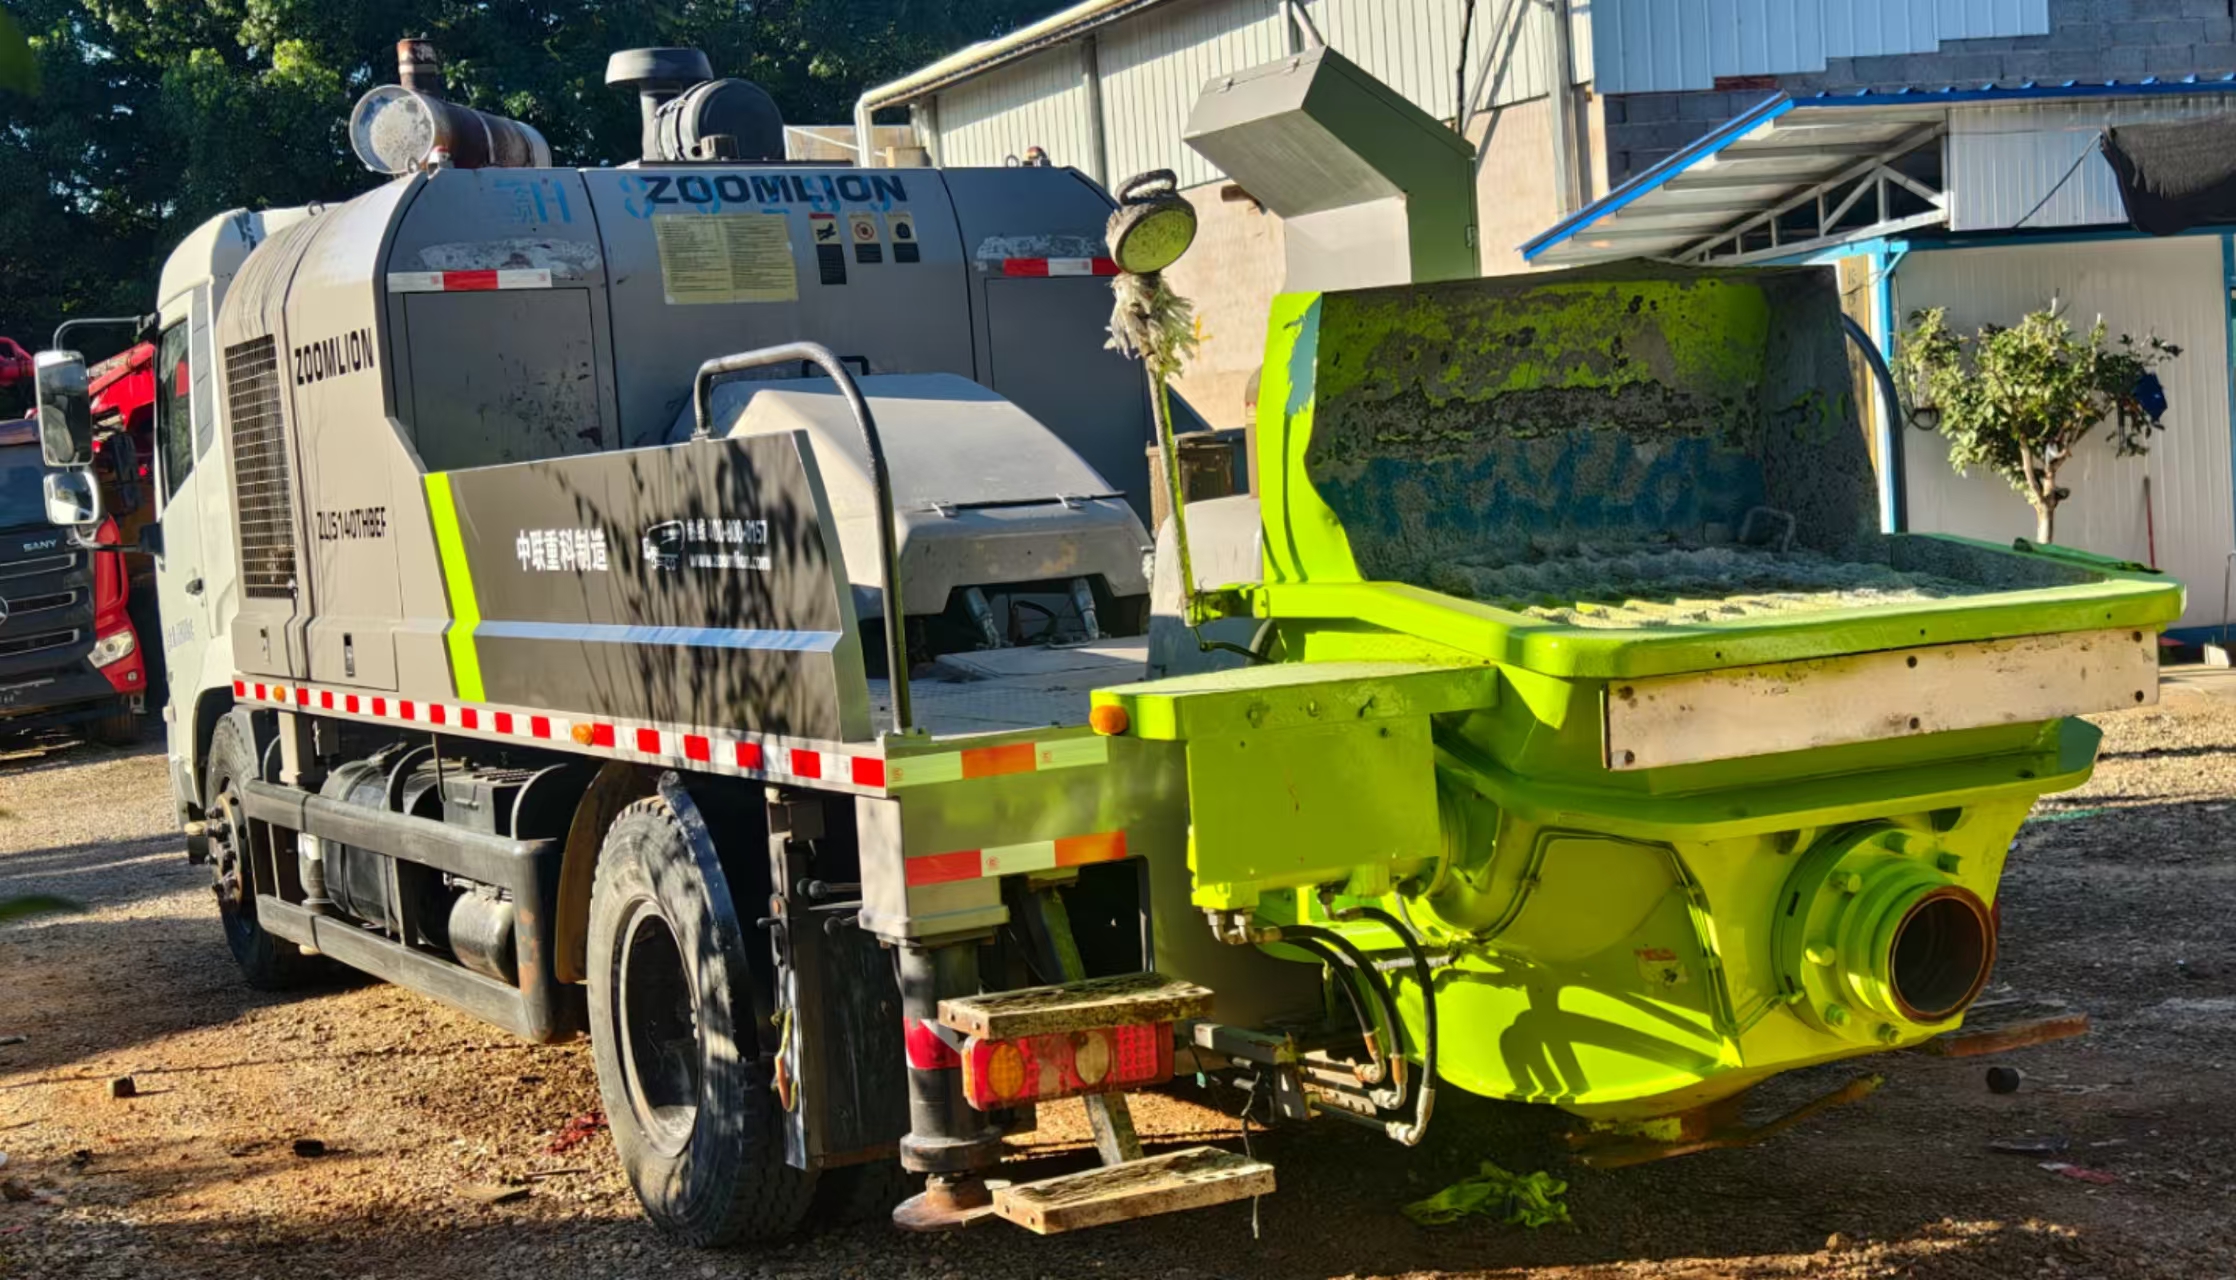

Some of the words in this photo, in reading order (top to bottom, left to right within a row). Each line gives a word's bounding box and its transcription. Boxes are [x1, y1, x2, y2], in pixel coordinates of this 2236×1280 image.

[640, 173, 908, 205] ZOOMLION
[294, 326, 375, 387] ZOOMLION
[22, 539, 57, 552] SANY
[515, 527, 609, 572] 中联重科制造
